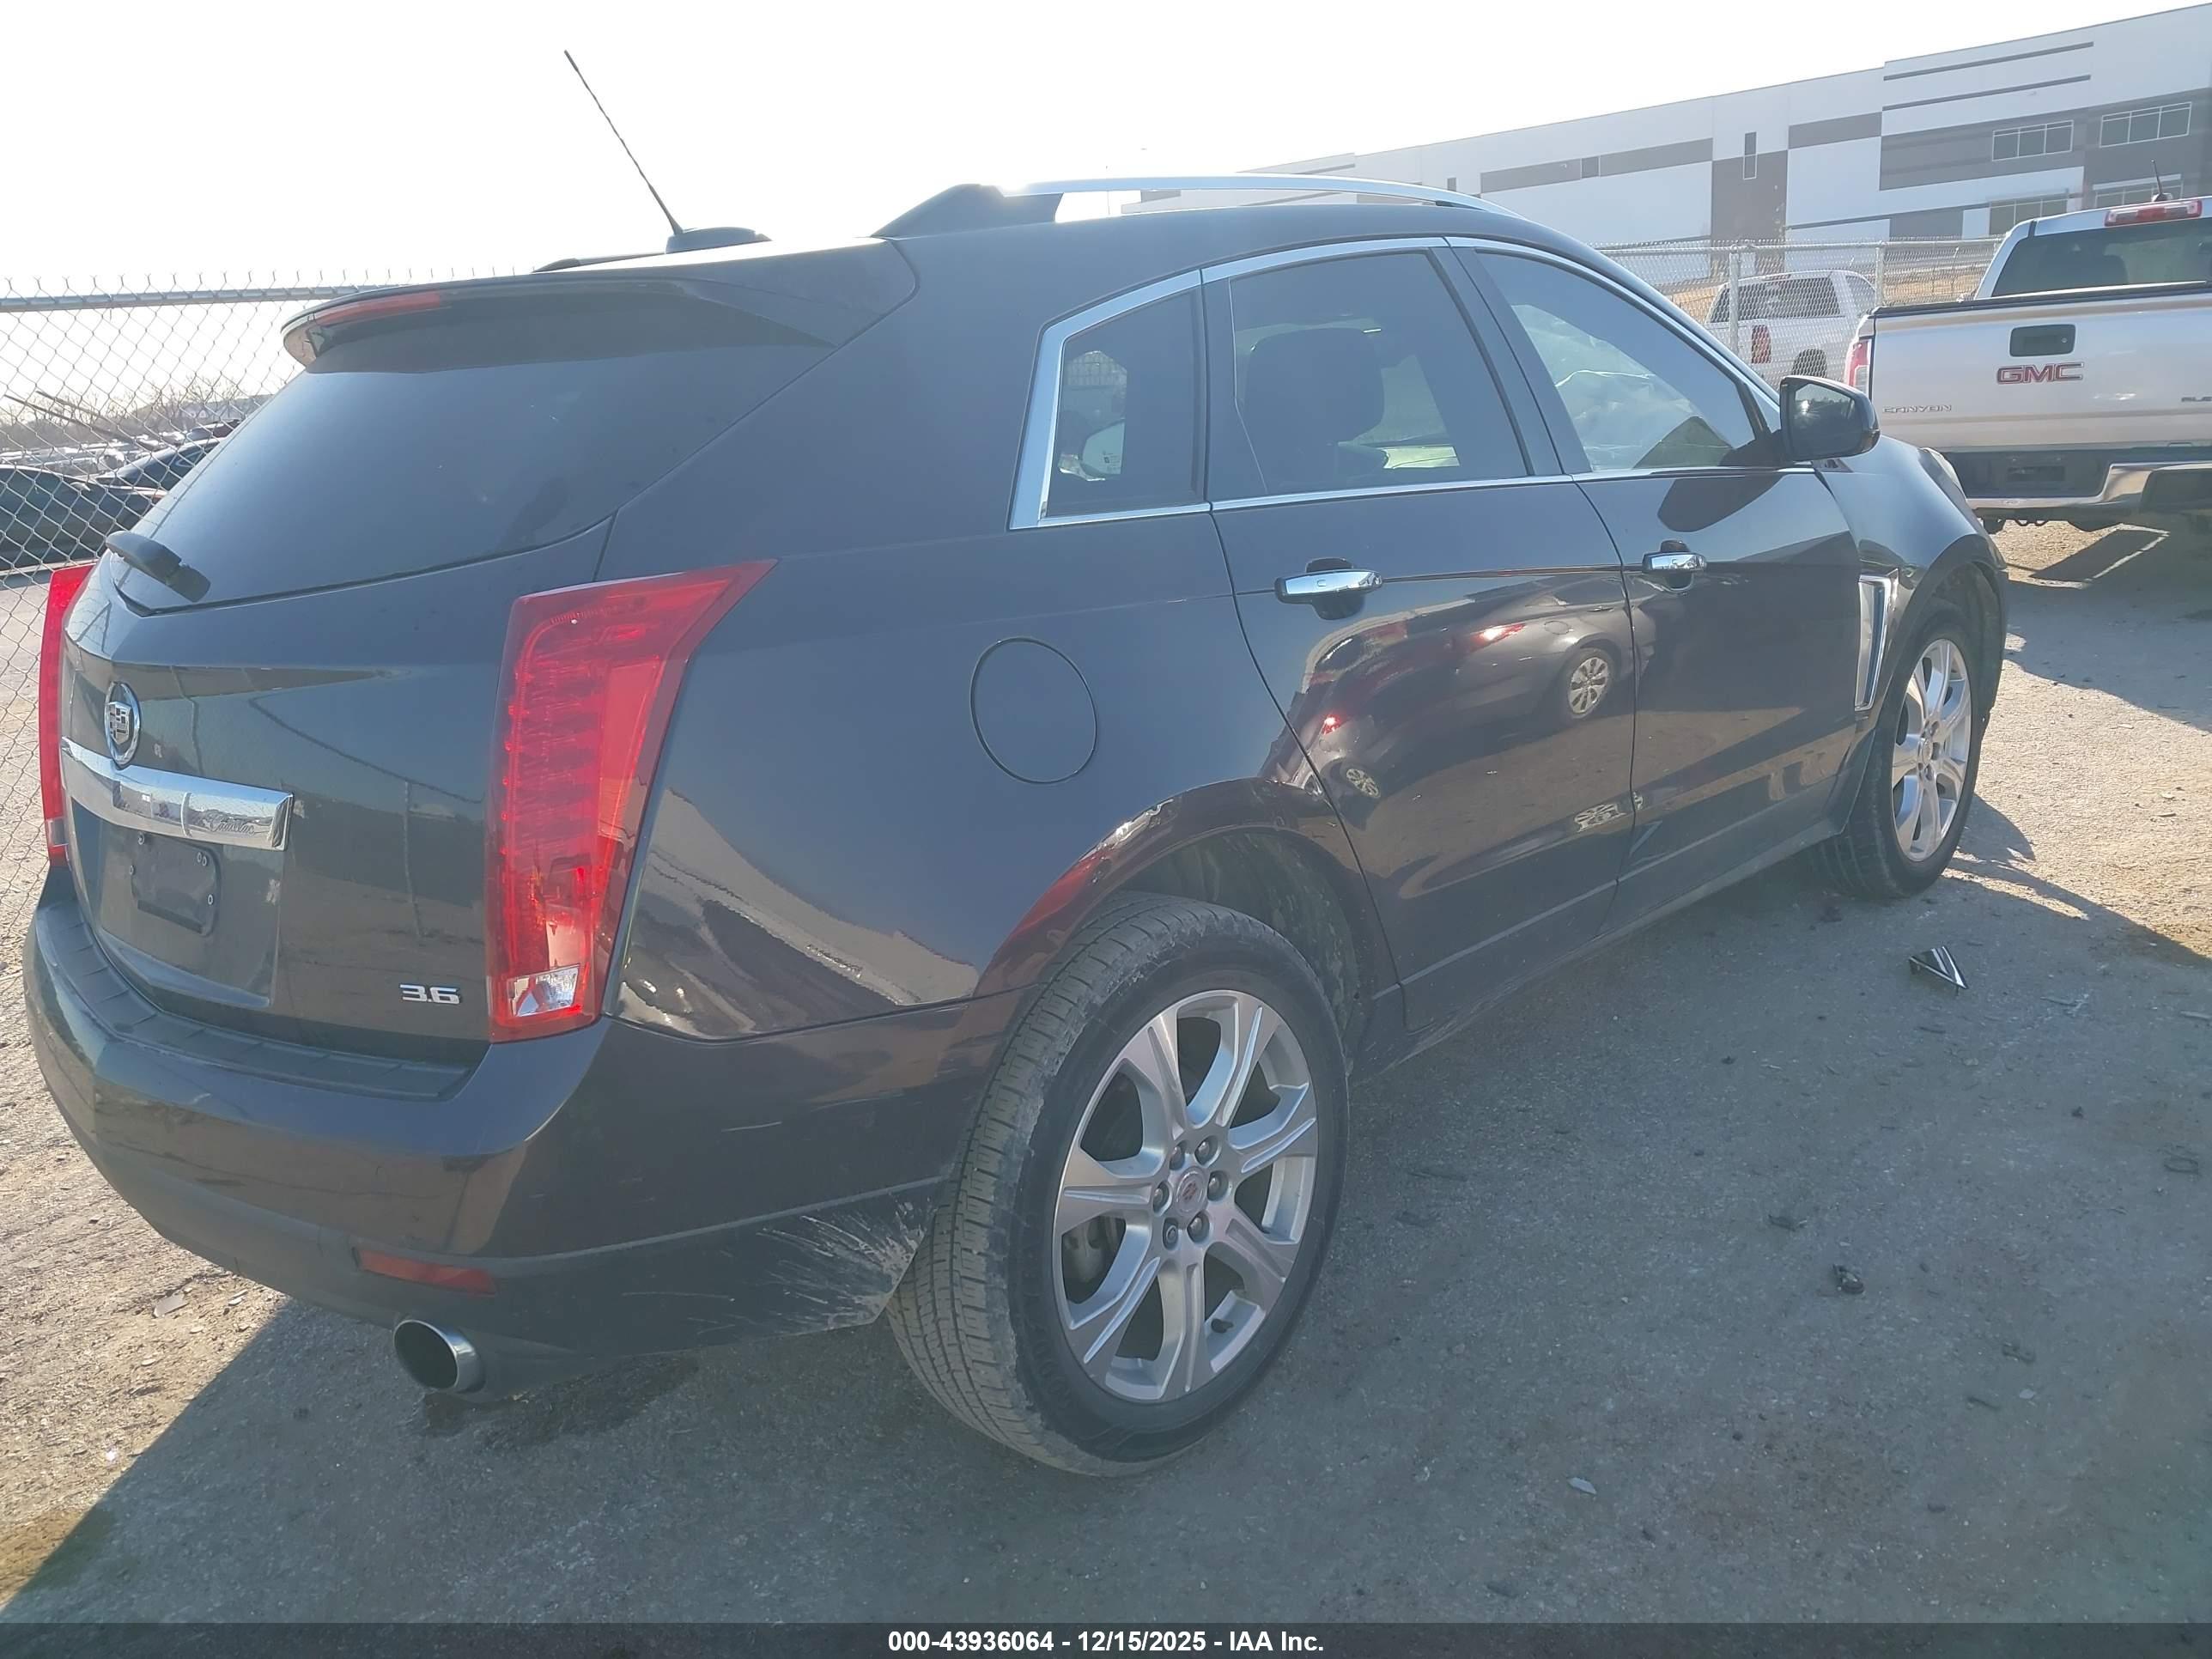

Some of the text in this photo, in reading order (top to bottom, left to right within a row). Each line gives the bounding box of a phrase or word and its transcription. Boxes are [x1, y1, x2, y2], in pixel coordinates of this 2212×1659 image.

[1996, 362, 2084, 385] GMC
[1883, 404, 1953, 414] CANYON
[399, 983, 461, 1005] 3.6
